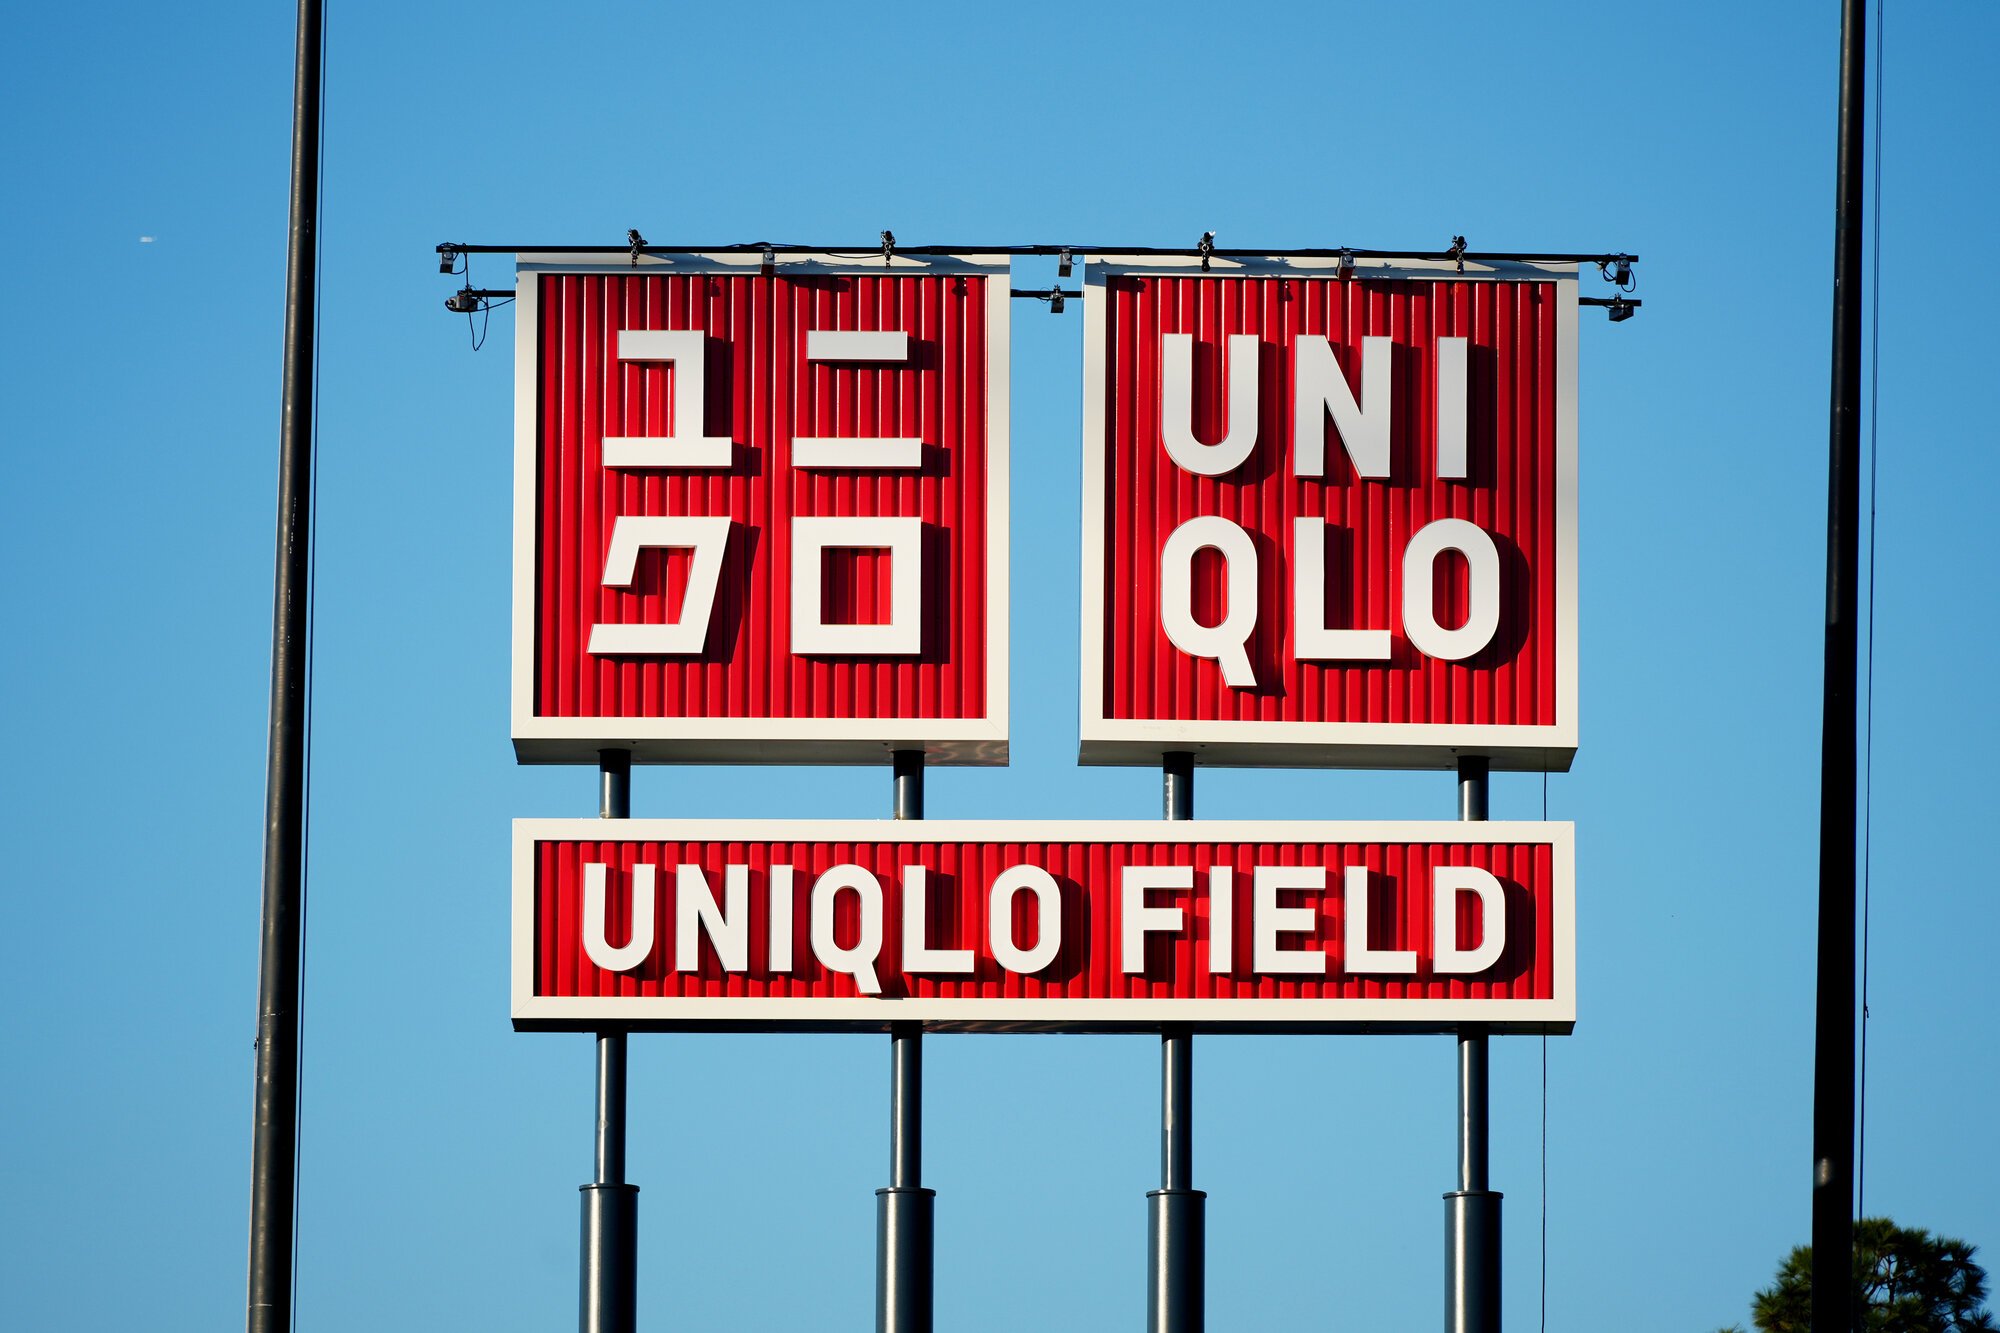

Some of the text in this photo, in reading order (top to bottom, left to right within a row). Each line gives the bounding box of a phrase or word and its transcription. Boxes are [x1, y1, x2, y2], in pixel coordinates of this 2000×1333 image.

[601, 329, 923, 469] ユニ
[1161, 332, 1469, 479] UNI
[587, 515, 923, 655] クロ
[1160, 515, 1501, 689] QLO
[582, 862, 1507, 995] UNIQLO FIELD
